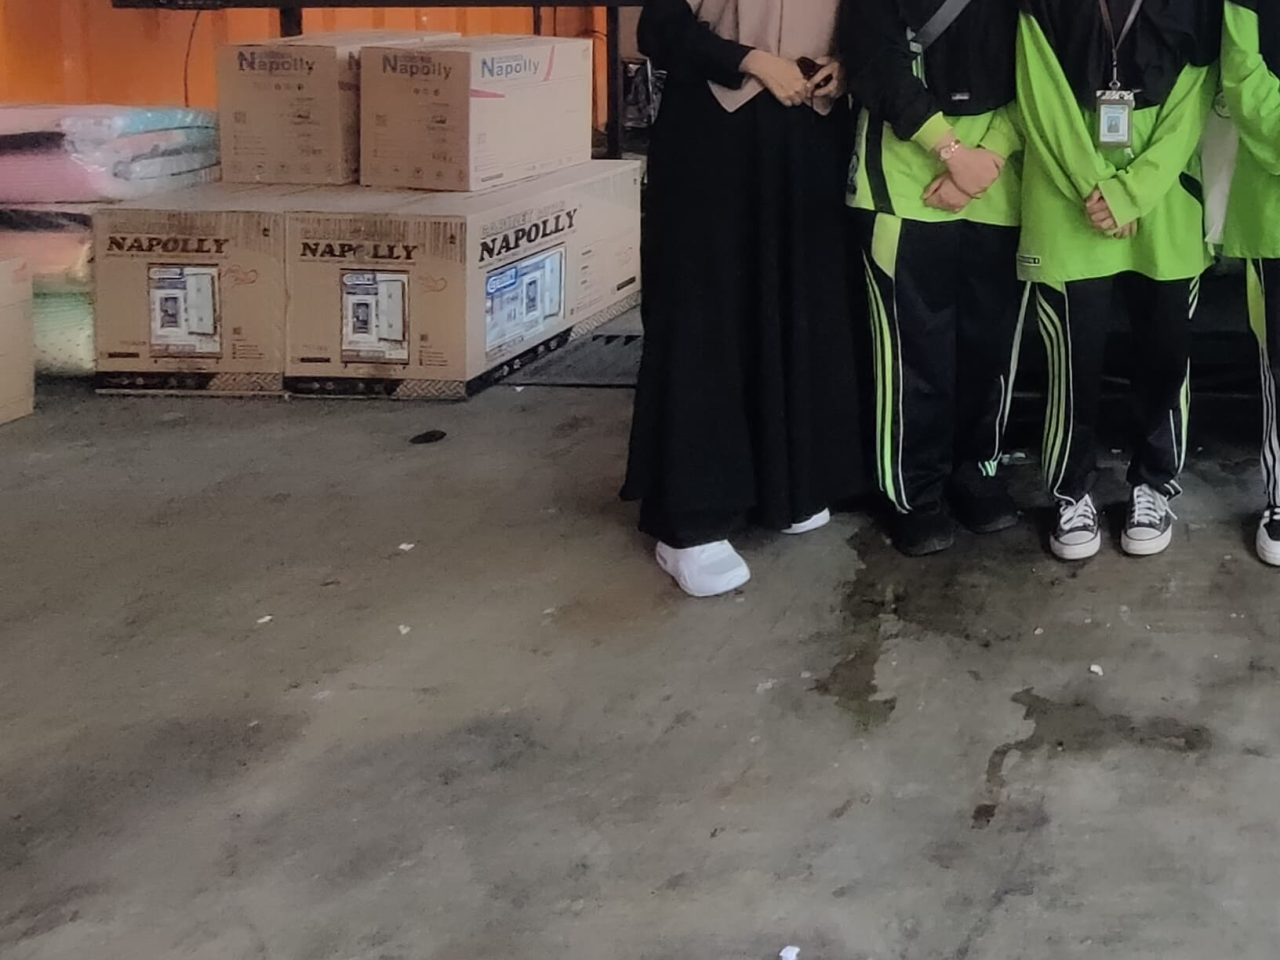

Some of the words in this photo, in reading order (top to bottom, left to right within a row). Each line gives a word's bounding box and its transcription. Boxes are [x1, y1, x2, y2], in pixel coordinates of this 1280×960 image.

[238, 51, 315, 76] Napolly
[382, 54, 452, 80] Napolly
[481, 56, 540, 78] Napolly
[107, 236, 229, 253] NAPOLLY
[478, 208, 577, 262] NAPOLLY
